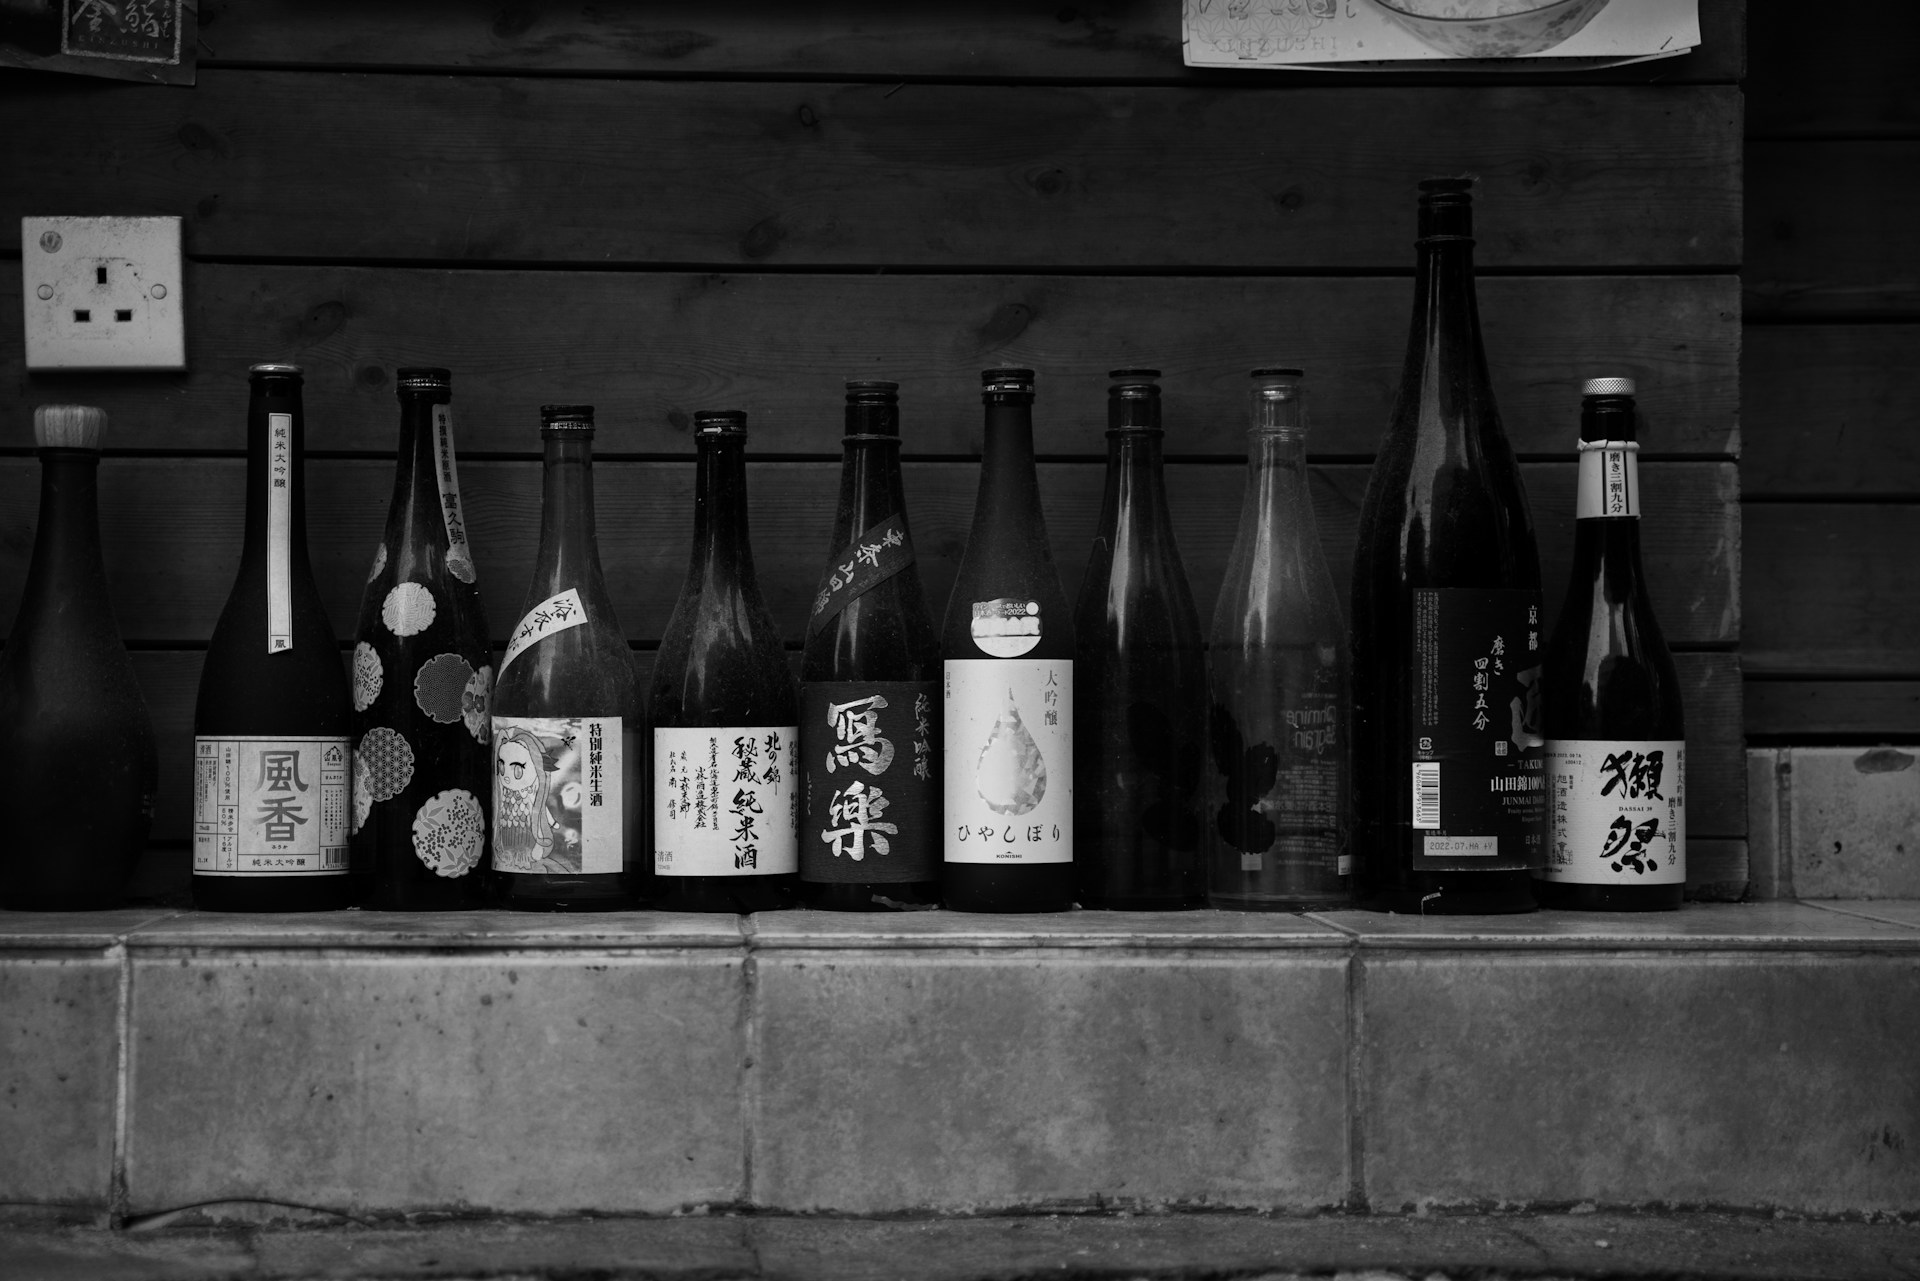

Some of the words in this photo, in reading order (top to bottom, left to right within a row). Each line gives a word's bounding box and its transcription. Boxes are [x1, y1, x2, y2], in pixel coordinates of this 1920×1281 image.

[274, 428, 286, 488] 純米大吟醸
[1609, 452, 1623, 513] 磨き三割九分
[1490, 635, 1505, 676] 磨き
[1528, 605, 1538, 651] 京都
[1044, 669, 1058, 726] 大吟醸
[1472, 657, 1490, 731] 四割五分
[589, 723, 602, 807] 特別純米生酒
[763, 731, 782, 796] 北の錦
[912, 692, 932, 782] 純米吟醸
[253, 750, 309, 842] 風香
[657, 850, 673, 863] 清酒
[958, 824, 1061, 842] ひやしぼり
[1668, 797, 1676, 865] 磨き三割九分
[252, 858, 306, 867] 純米大吟醸
